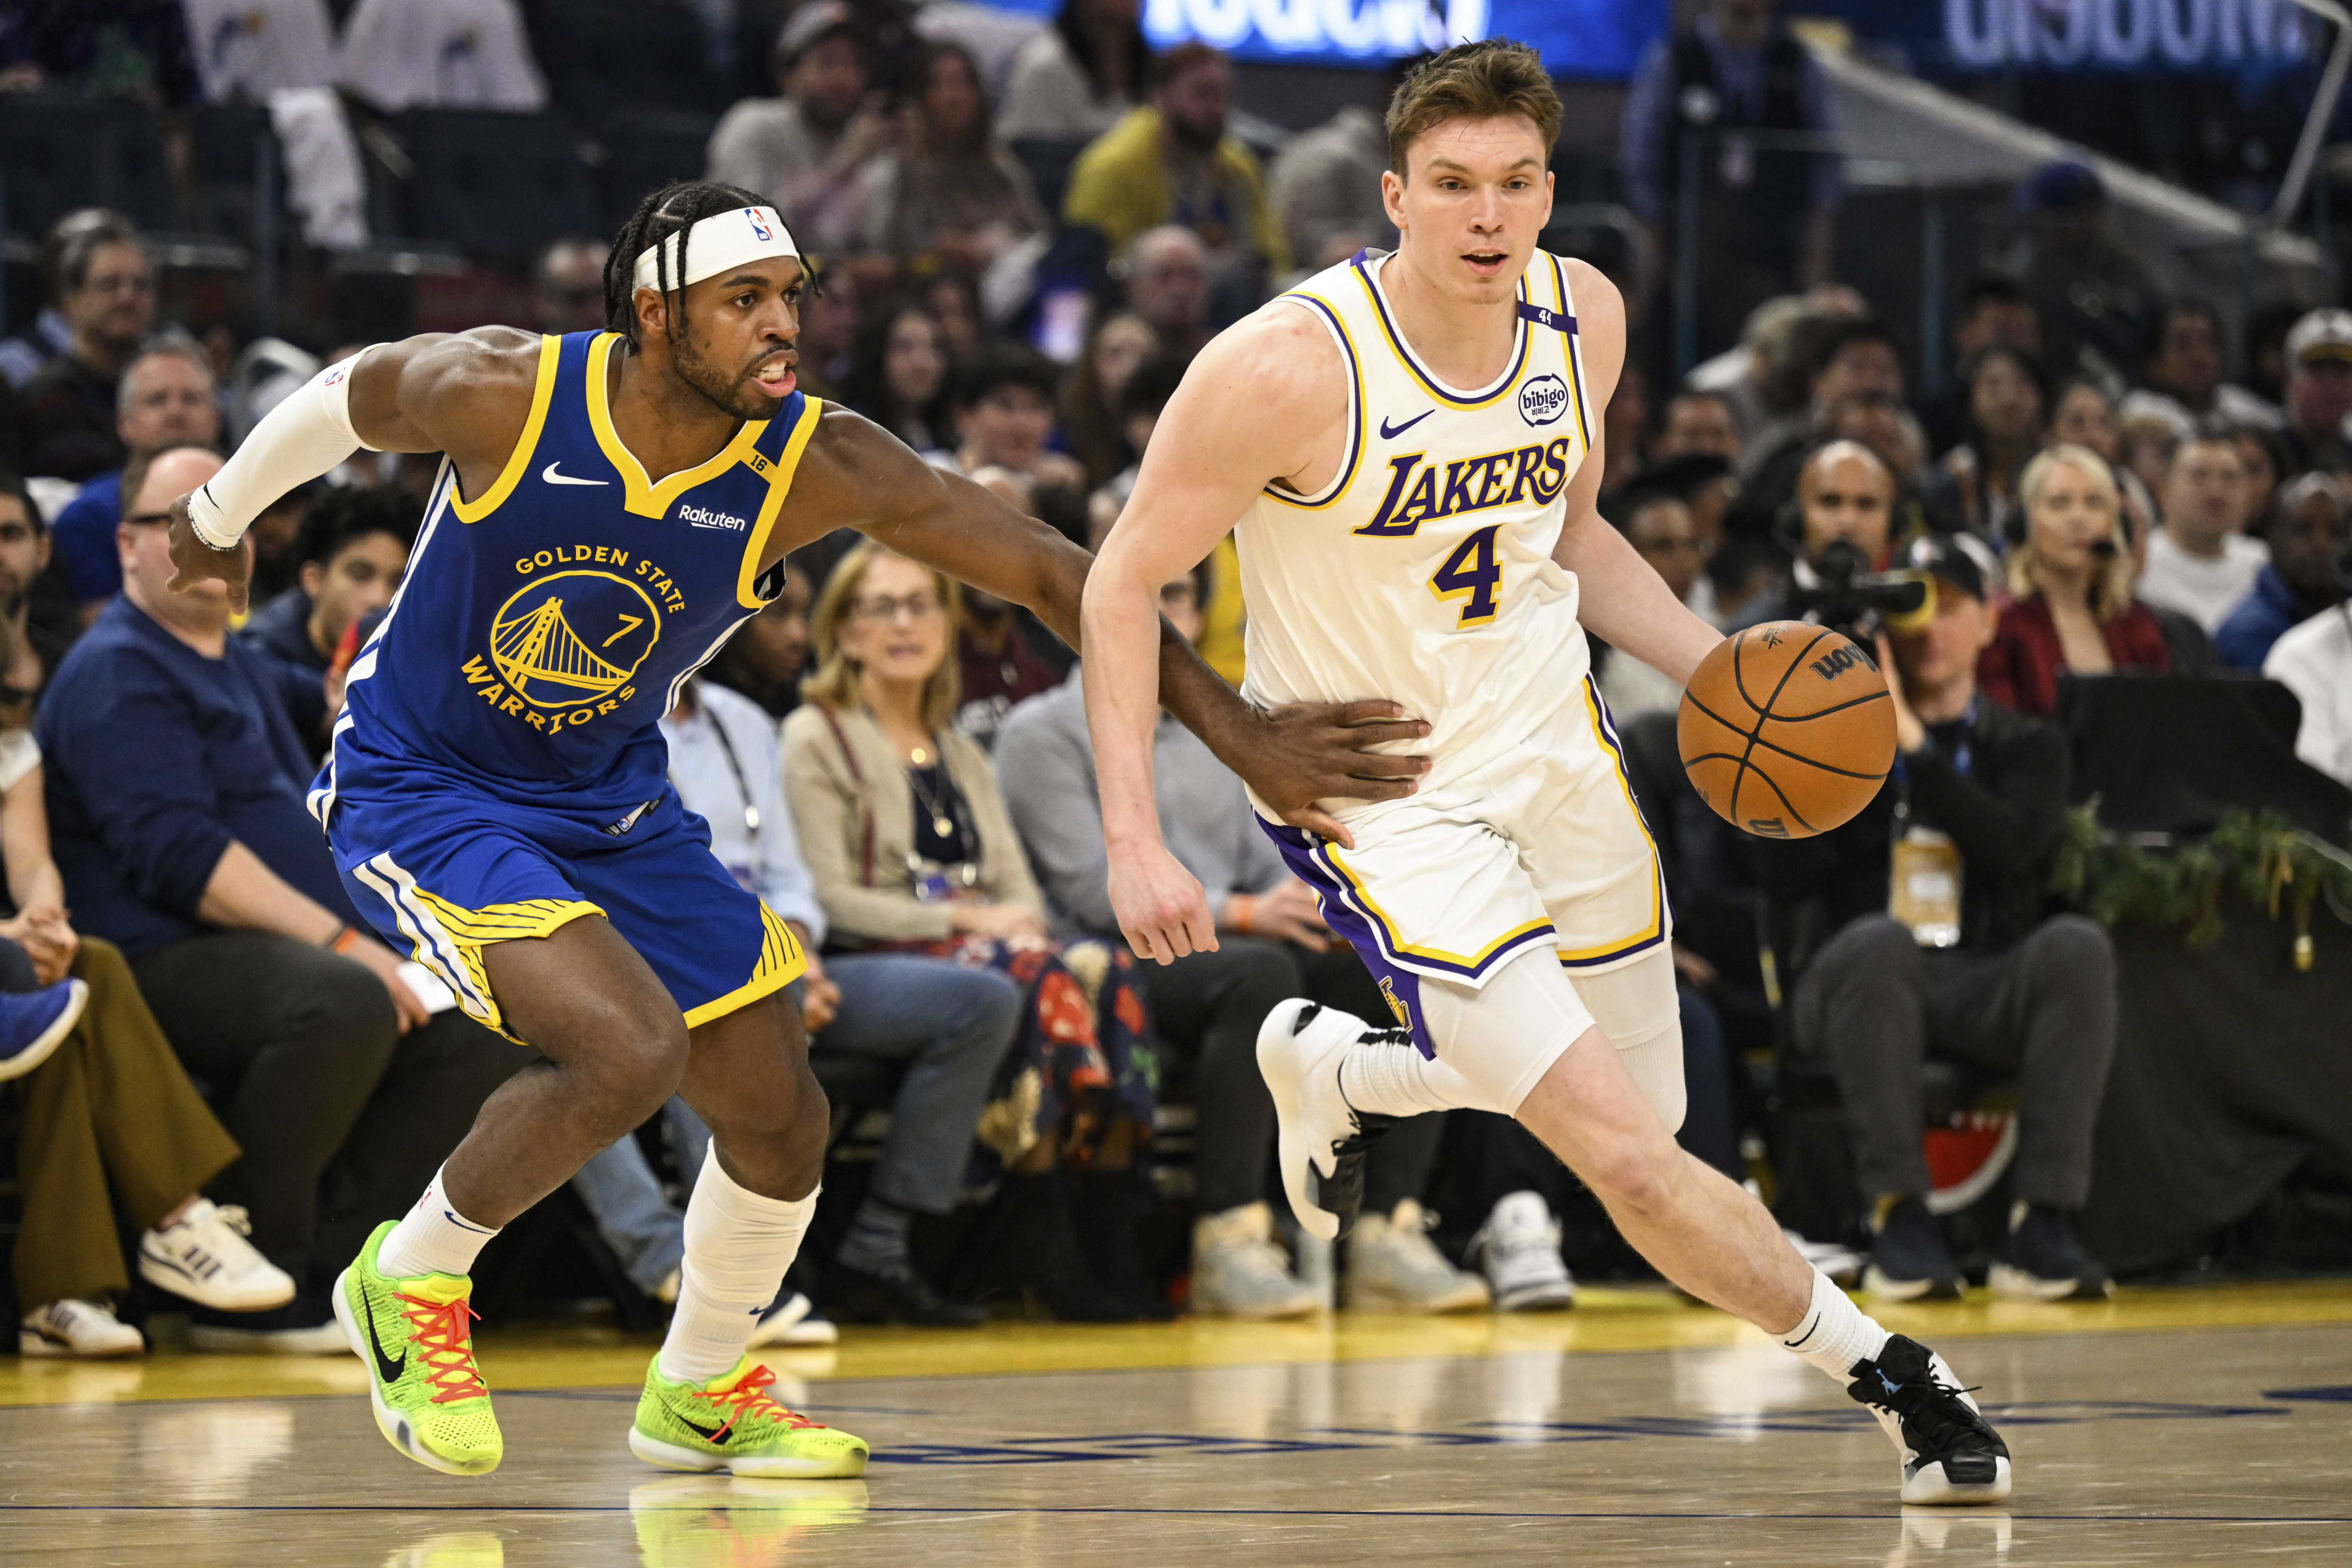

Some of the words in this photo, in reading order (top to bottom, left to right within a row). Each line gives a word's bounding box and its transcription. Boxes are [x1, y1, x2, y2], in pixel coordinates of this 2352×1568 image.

[1539, 309, 1552, 325] 44
[1522, 388, 1565, 409] bibigo
[1531, 406, 1550, 416] 비비고
[750, 454, 767, 471] 16
[1349, 436, 1572, 538] LAKERS
[678, 505, 745, 531] Rakuten
[516, 545, 629, 574] GOLDEN
[635, 560, 685, 614] STATE
[1426, 523, 1507, 630] 4
[602, 613, 644, 647] 7
[461, 654, 636, 735] WARRIORS
